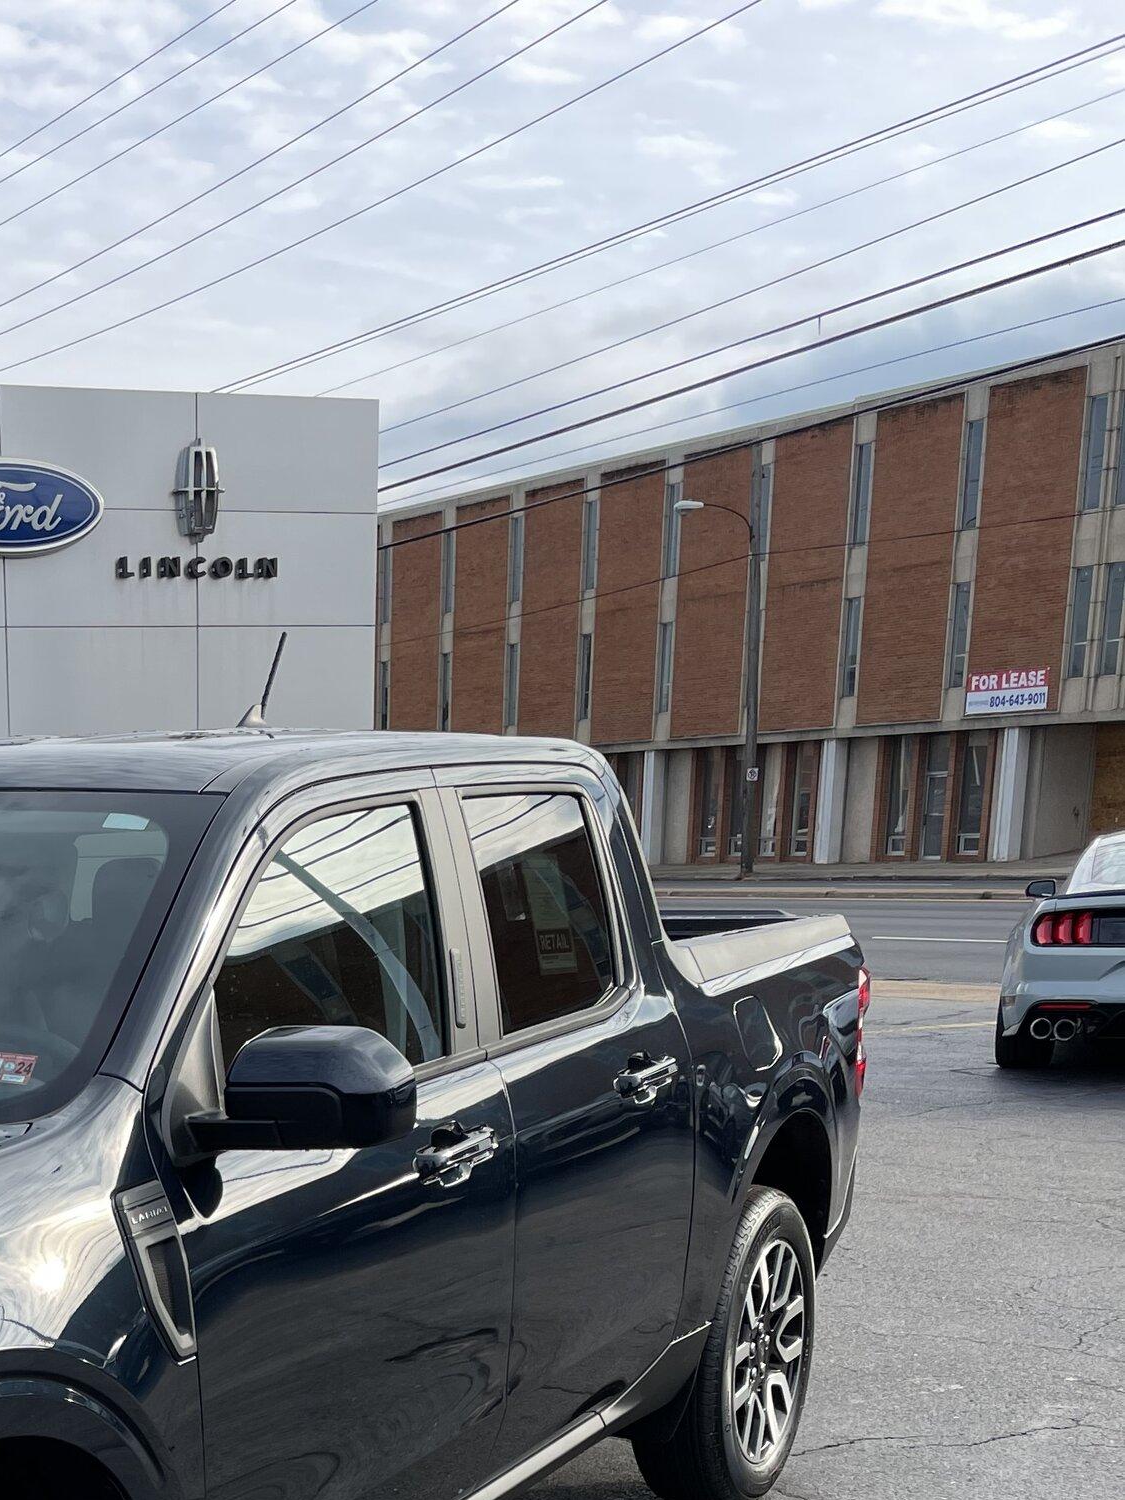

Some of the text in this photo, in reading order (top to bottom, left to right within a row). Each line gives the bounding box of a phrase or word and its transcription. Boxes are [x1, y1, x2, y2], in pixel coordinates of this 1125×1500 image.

[115, 556, 278, 580] LINCOLN
[971, 669, 1046, 691] FOR LEASE
[989, 692, 1046, 708] 804-643-9011
[539, 934, 570, 951] RETAIL
[14, 1061, 34, 1076] 24
